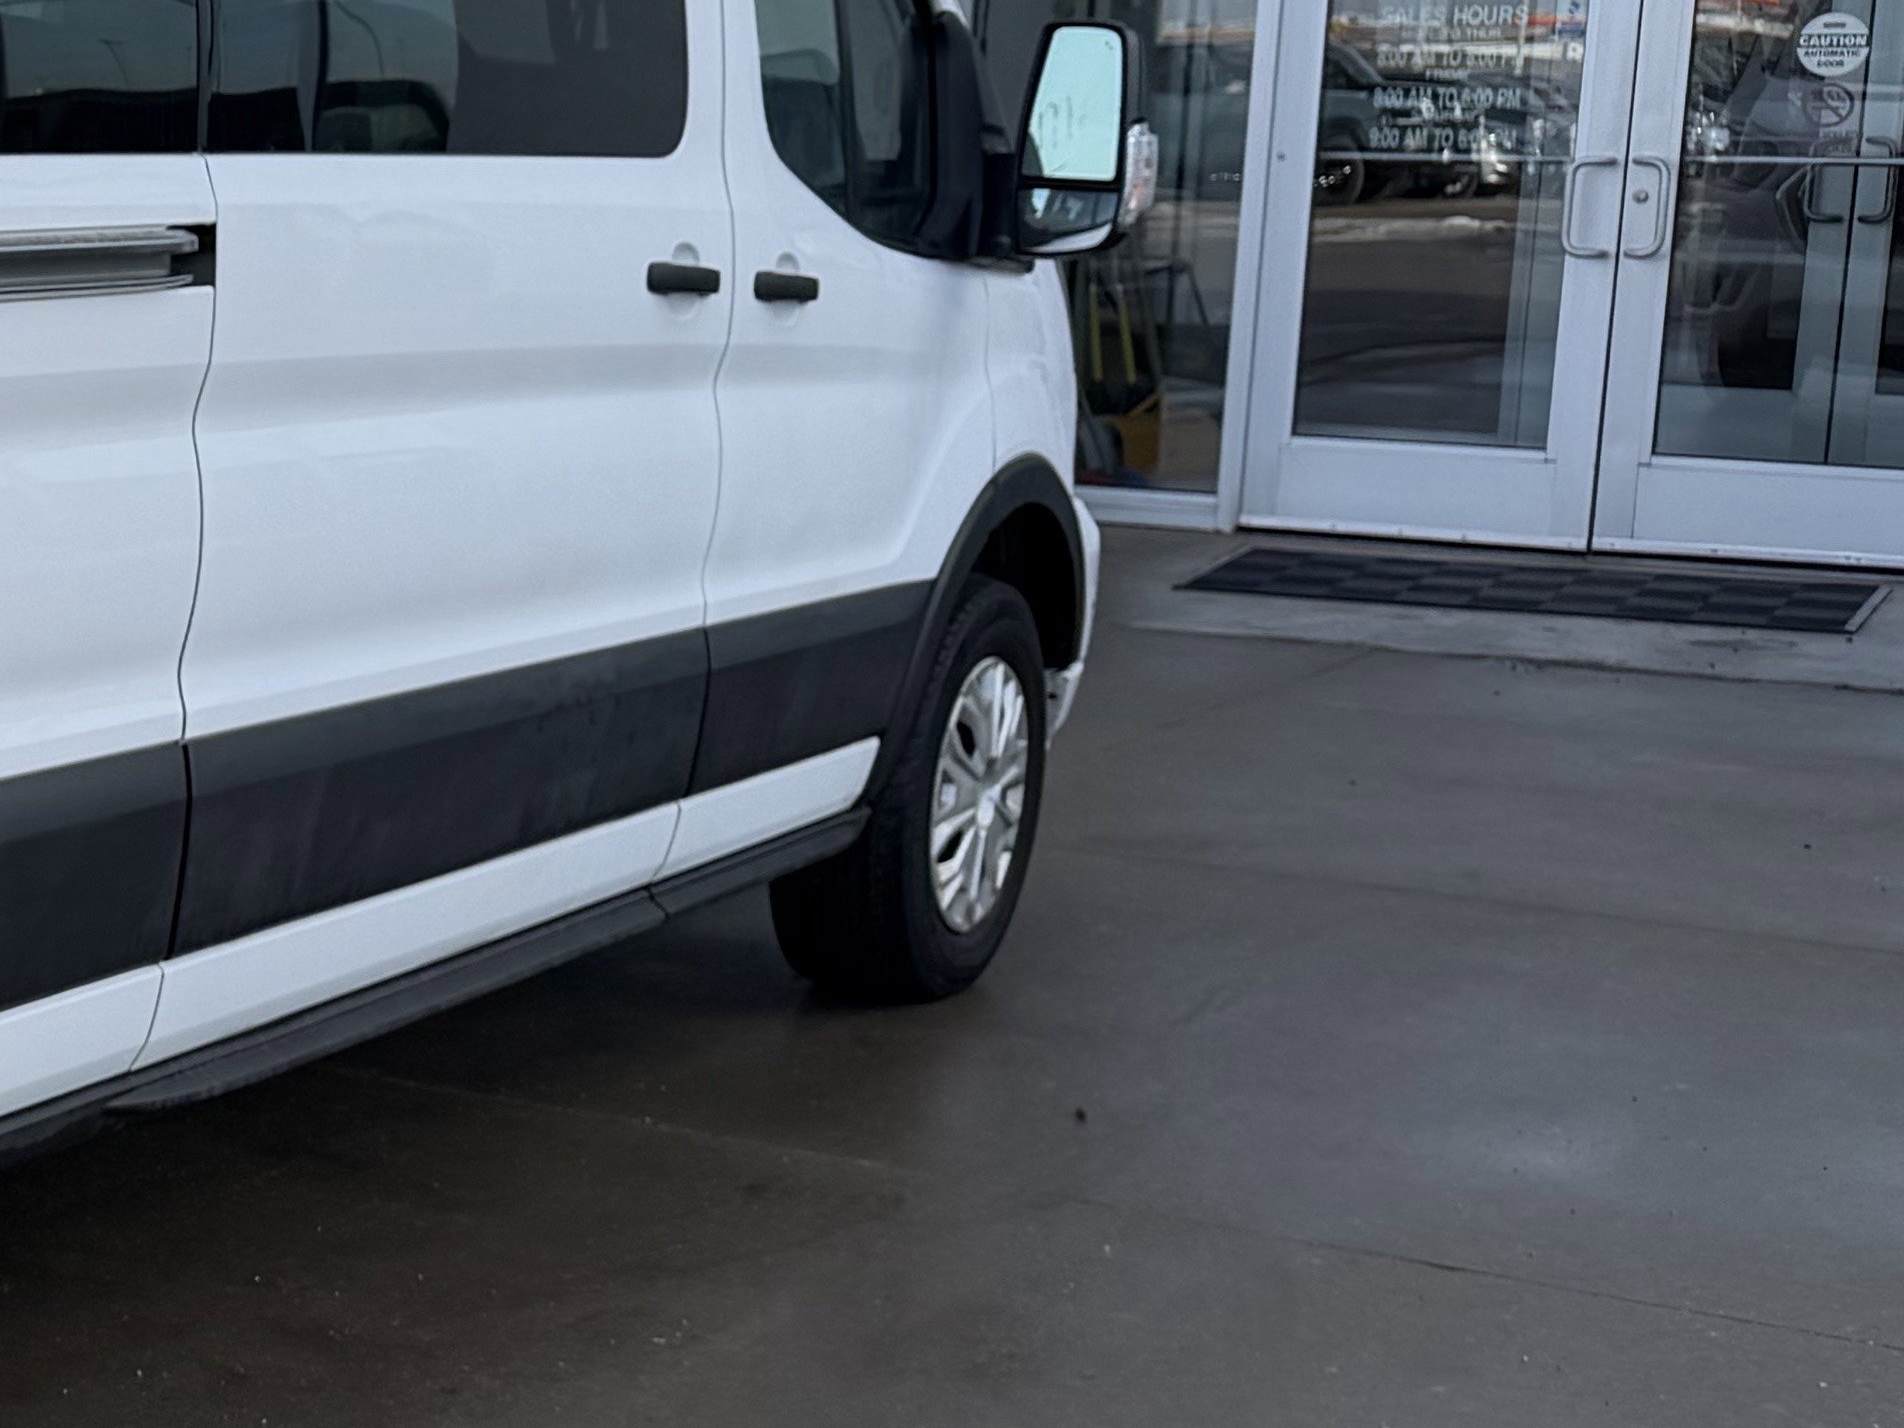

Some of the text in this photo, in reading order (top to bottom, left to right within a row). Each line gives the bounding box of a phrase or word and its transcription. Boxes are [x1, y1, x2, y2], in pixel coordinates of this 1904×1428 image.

[1453, 4, 1529, 26] HOURS
[1798, 33, 1868, 47] CAUTION
[1438, 86, 1459, 109] TO
[1496, 87, 1522, 109] PM
[1403, 127, 1429, 150] AM
[1433, 126, 1455, 150] TO
